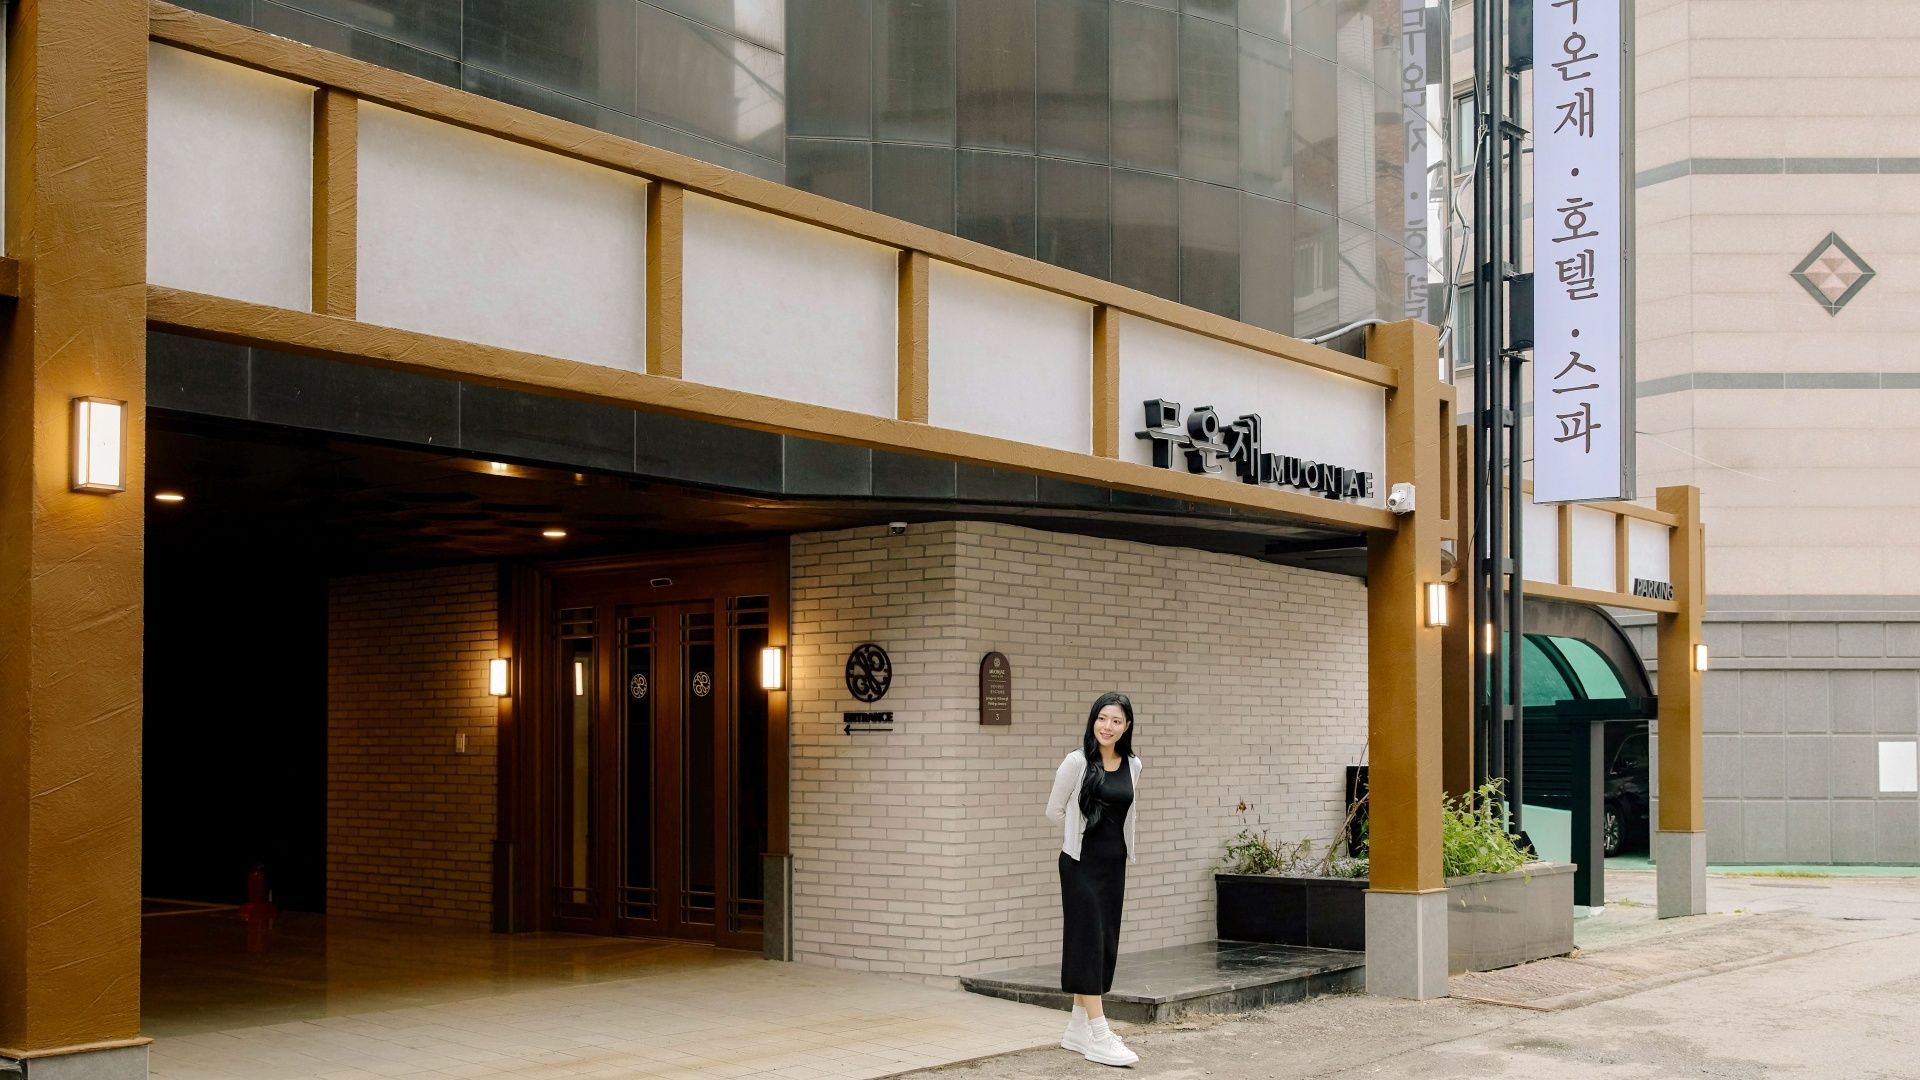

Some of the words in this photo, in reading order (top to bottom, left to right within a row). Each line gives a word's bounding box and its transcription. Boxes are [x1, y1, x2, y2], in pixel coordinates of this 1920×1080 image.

[1551, 197, 1599, 301] 호텔
[1135, 398, 1261, 486] 무온재
[1552, 351, 1601, 454] 스파
[1634, 578, 1674, 600] PARKING
